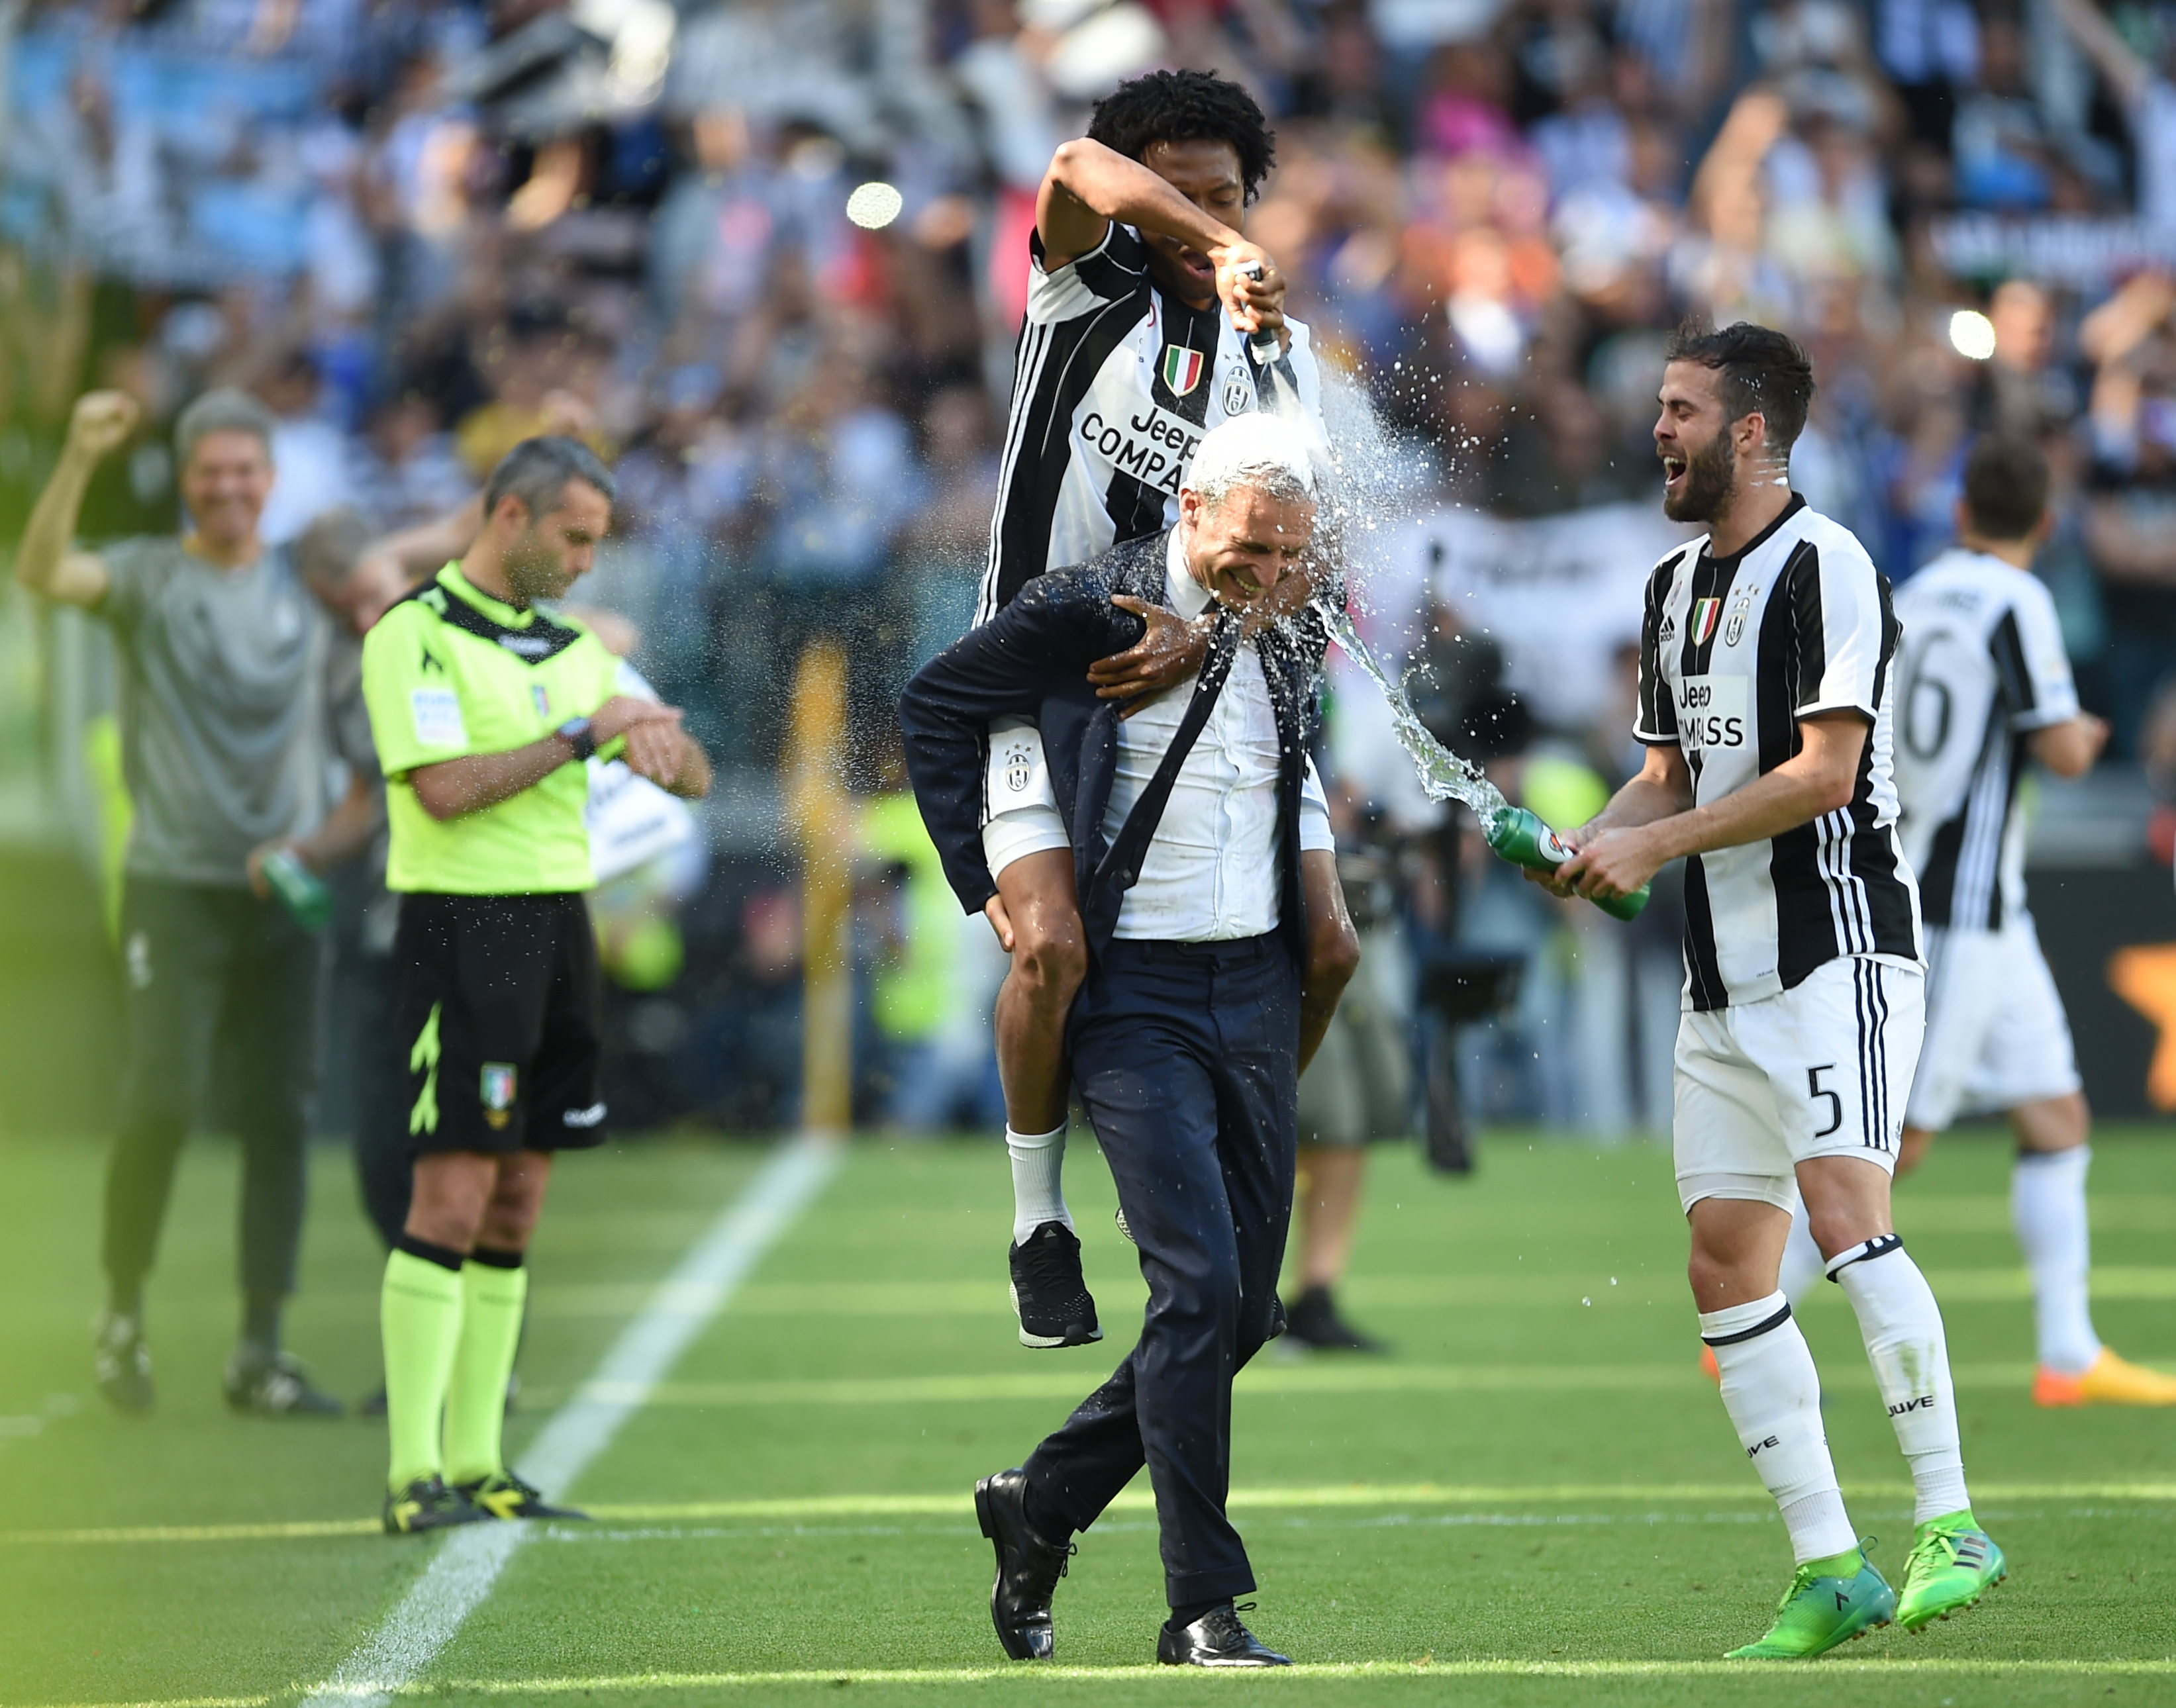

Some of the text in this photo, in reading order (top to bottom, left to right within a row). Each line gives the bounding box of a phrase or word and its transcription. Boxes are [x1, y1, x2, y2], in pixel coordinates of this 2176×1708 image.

[1080, 412, 1183, 495] COMPA
[1130, 406, 1202, 461] Jeep
[1679, 679, 1711, 712] Jeep
[1899, 628, 1952, 761] 6
[1679, 716, 1743, 747] MPASS
[1806, 1063, 1843, 1140] 5
[1889, 1395, 1934, 1417] JUVE
[1746, 1435, 1780, 1458] UVE
